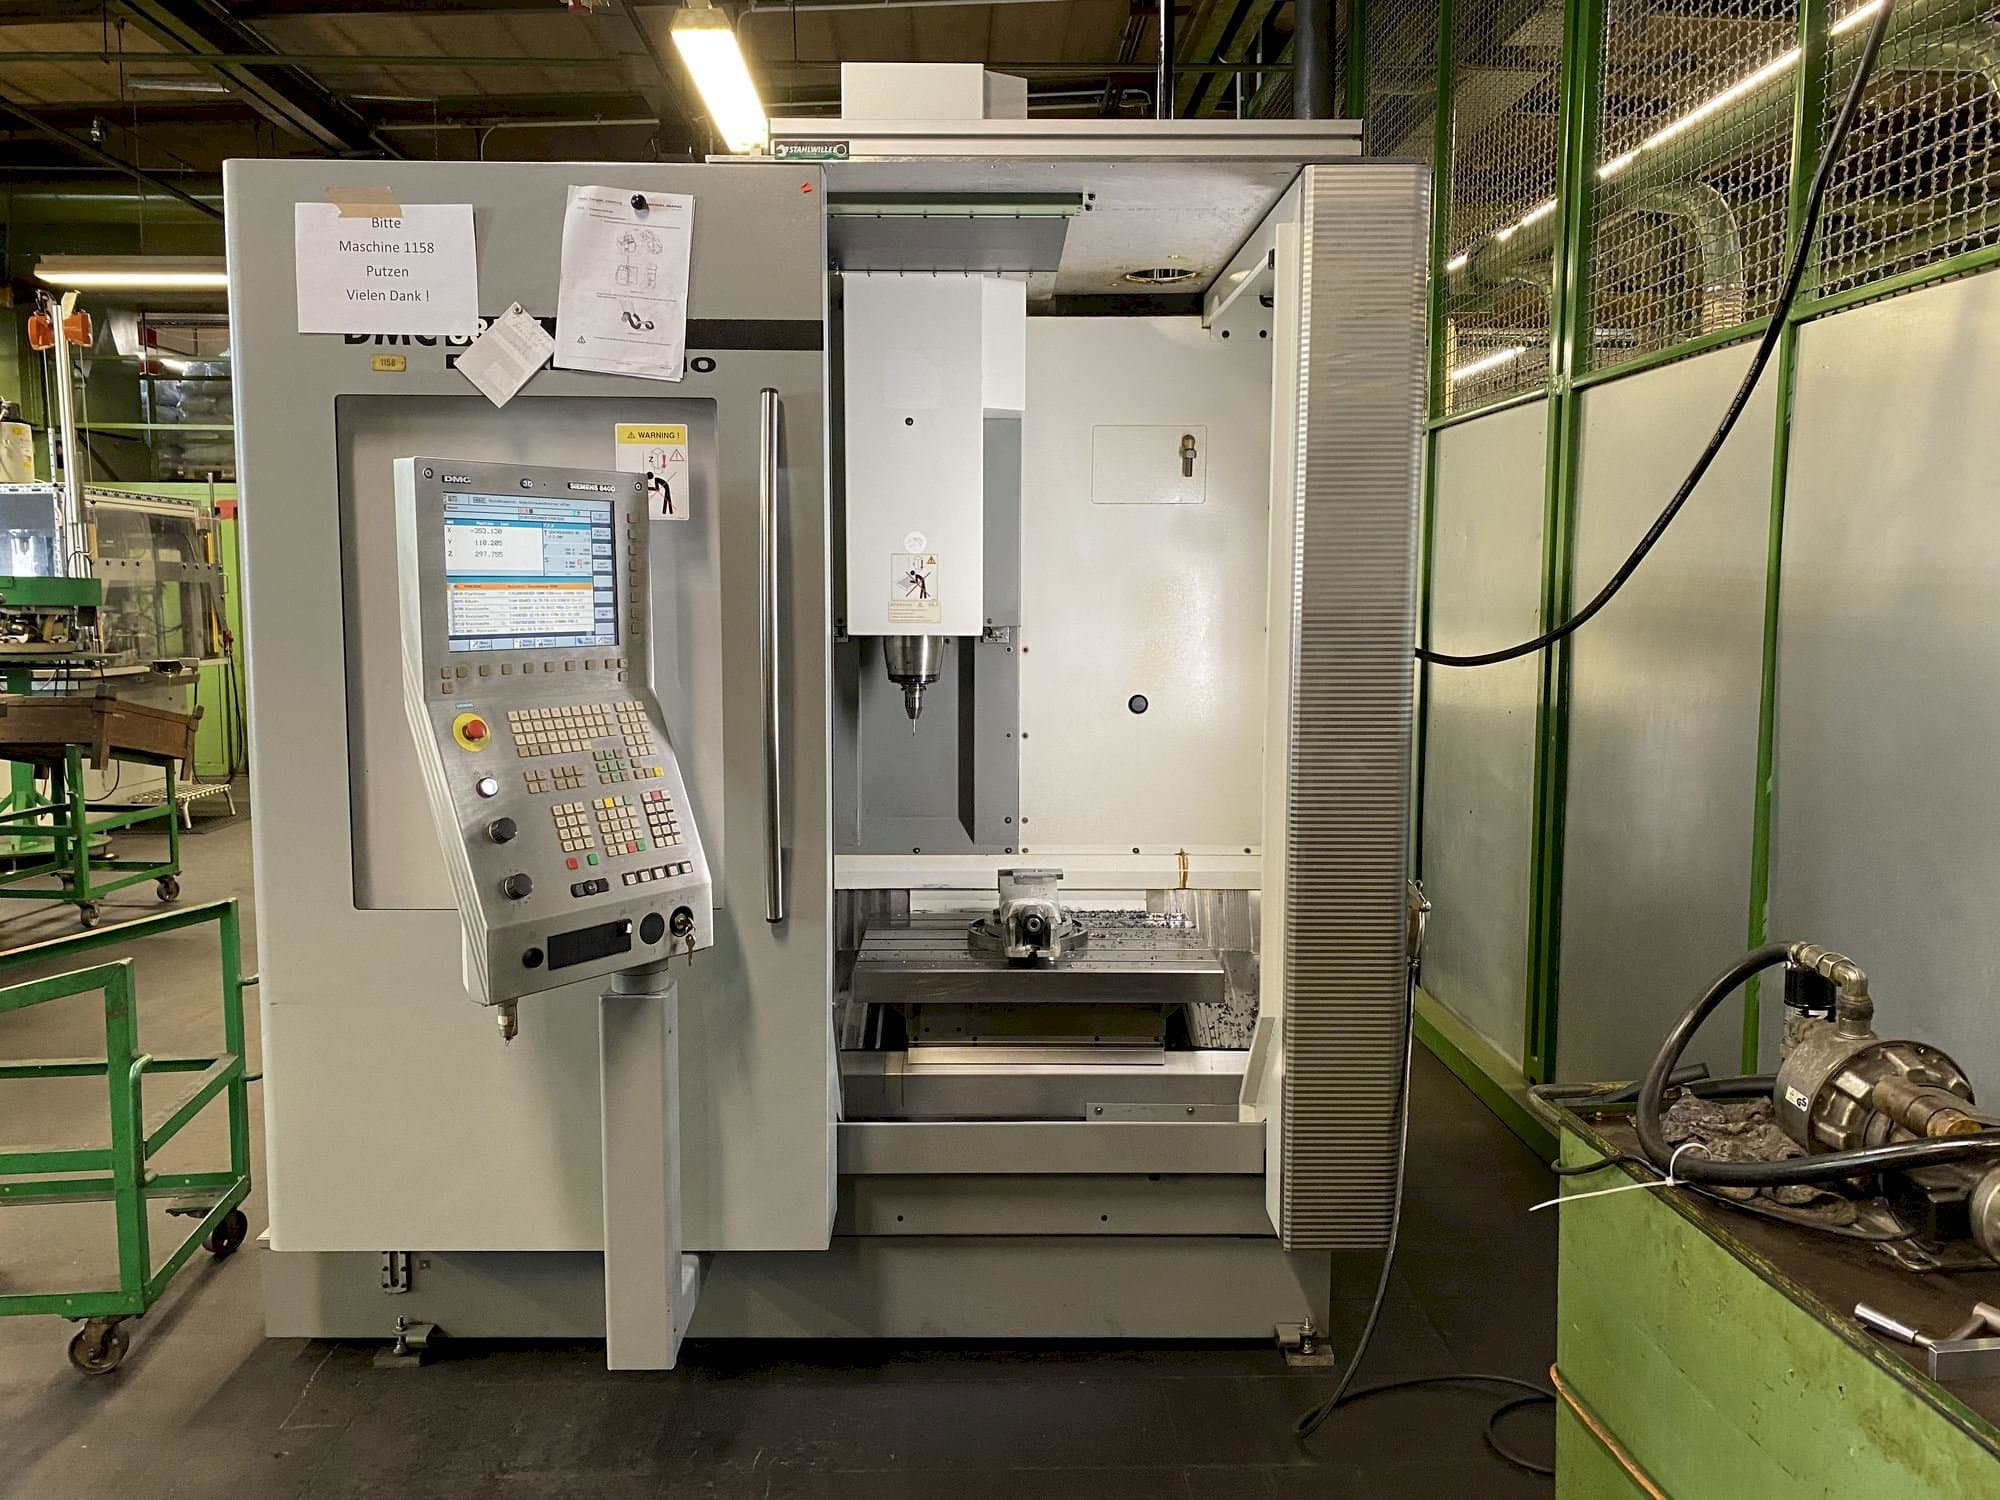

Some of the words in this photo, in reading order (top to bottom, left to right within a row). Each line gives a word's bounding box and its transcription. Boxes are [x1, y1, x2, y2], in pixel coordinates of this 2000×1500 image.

[371, 217, 401, 229] Bitte
[339, 240, 400, 253] Maschine
[404, 242, 434, 254] 1158
[366, 265, 409, 278] Putzen
[346, 289, 386, 301] Vielen
[390, 289, 422, 302] Dank
[637, 431, 675, 440] WARNING
